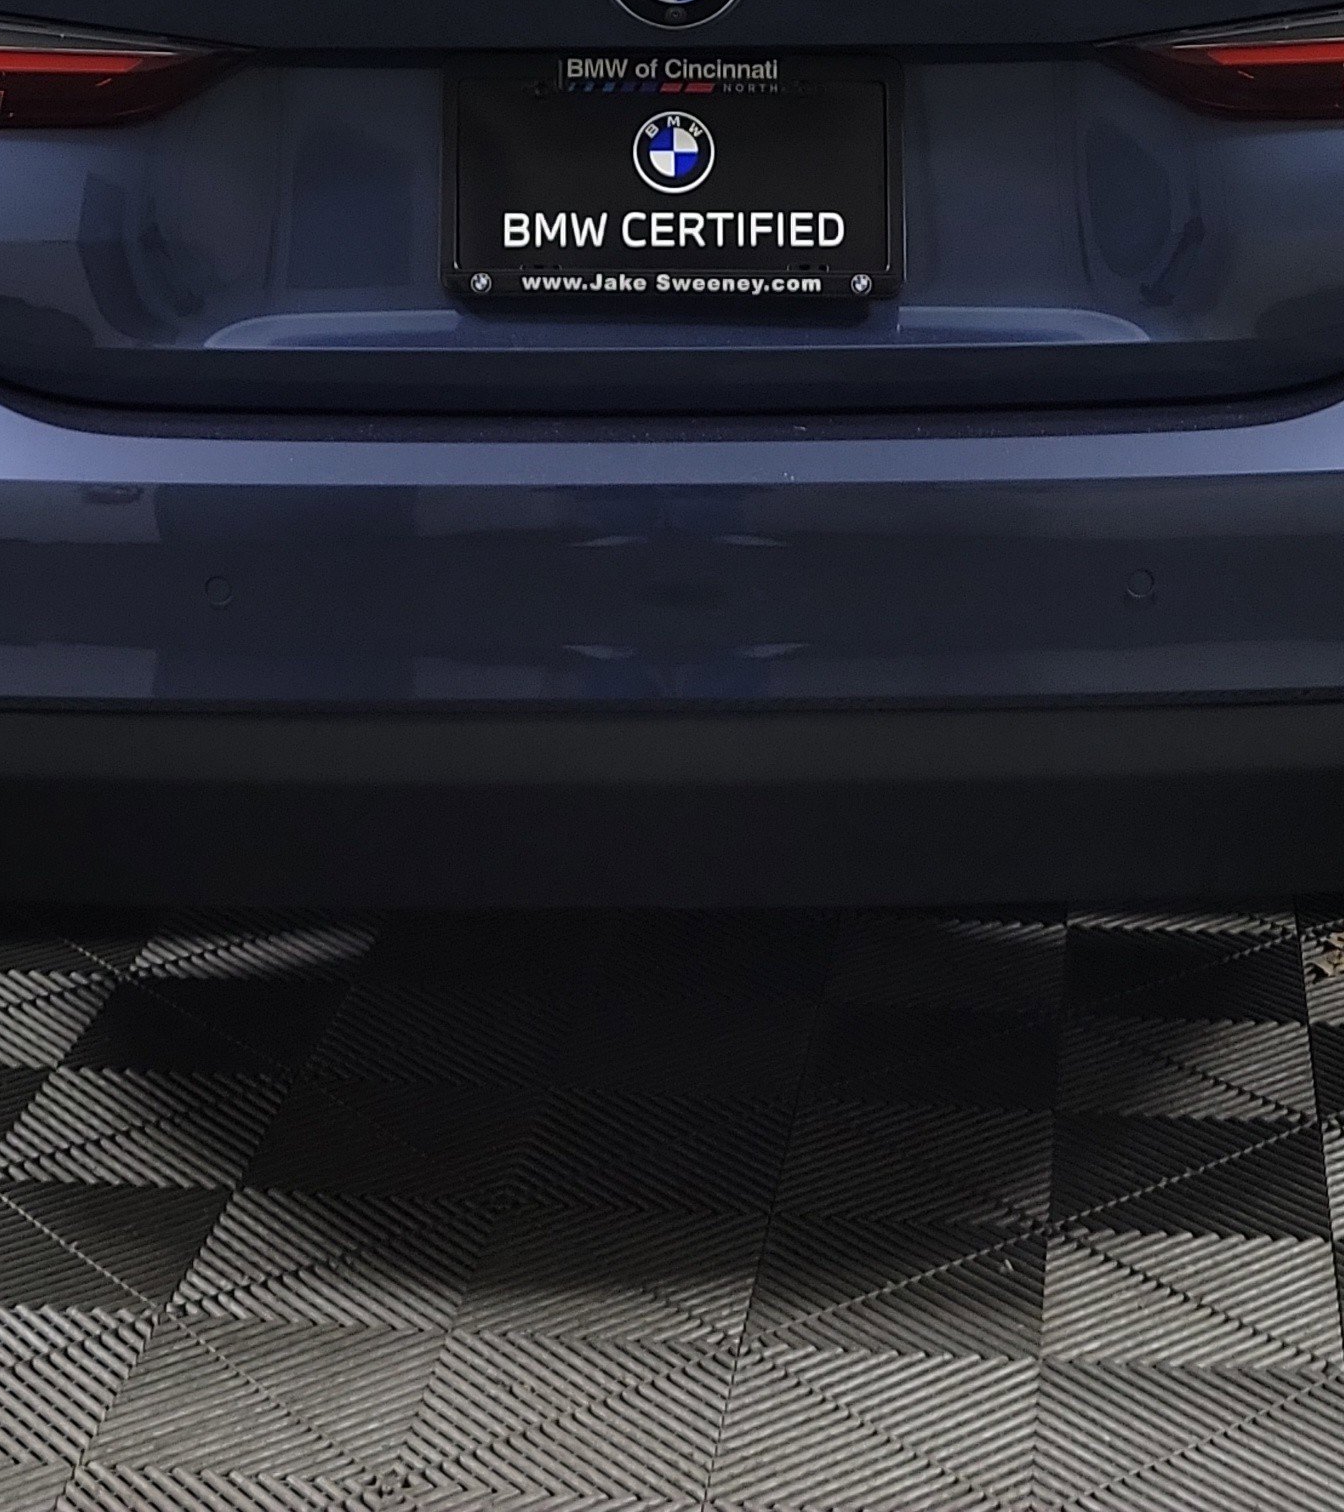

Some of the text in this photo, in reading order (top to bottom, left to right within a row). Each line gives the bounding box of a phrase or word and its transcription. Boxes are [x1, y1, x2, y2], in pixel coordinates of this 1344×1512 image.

[566, 58, 779, 80] BMW of Cincinnati
[723, 83, 779, 93] NORTH
[644, 115, 704, 139] BMW
[503, 211, 845, 248] BMW CERTIFIED
[521, 273, 823, 295] www.Jake Sweeney.com
